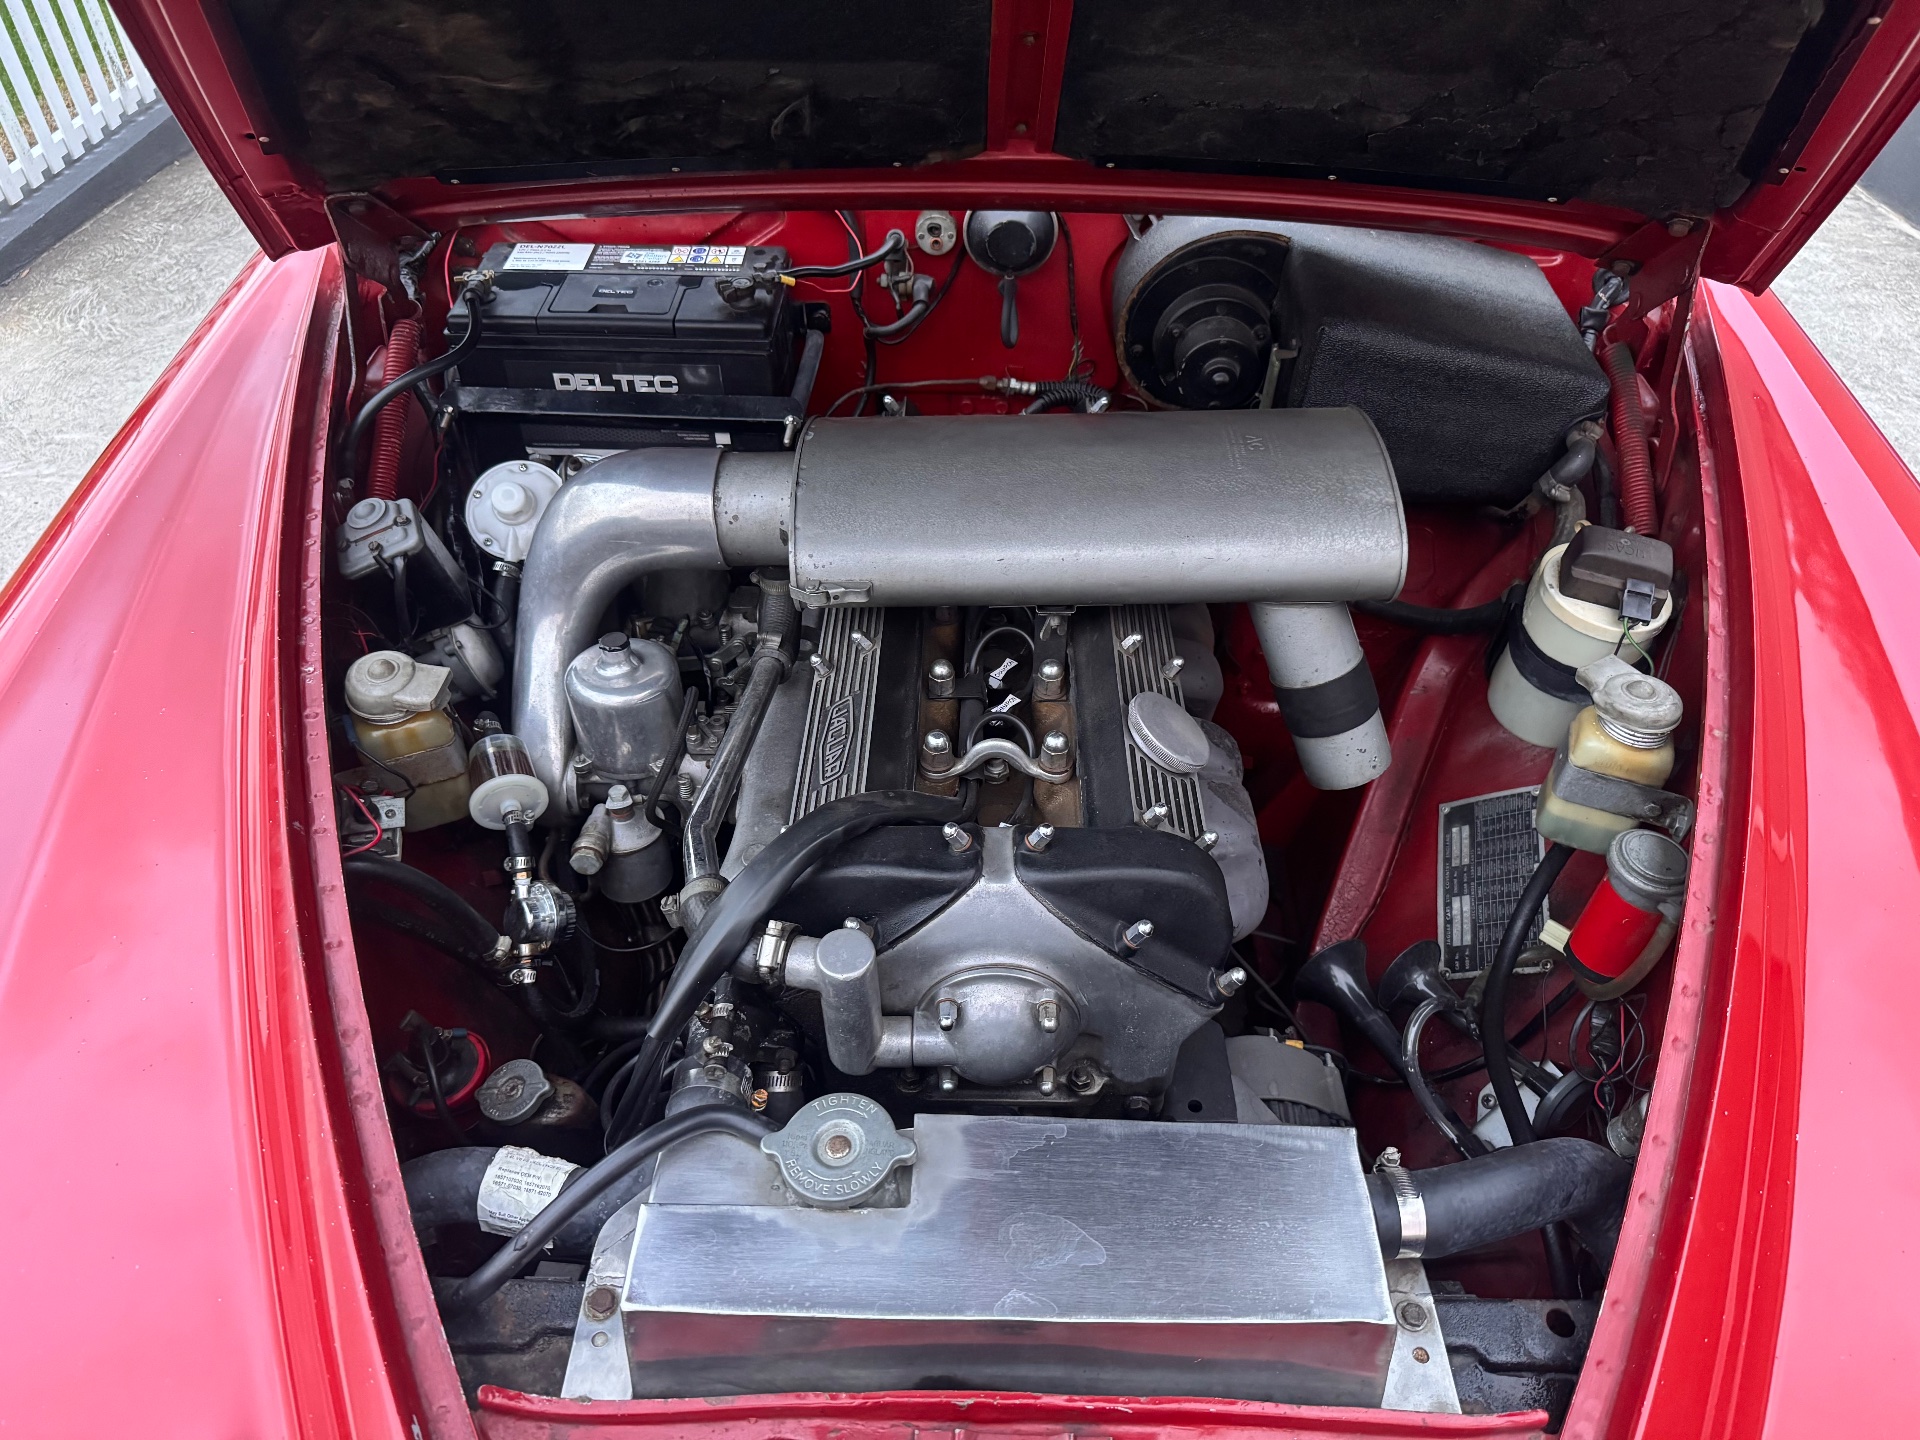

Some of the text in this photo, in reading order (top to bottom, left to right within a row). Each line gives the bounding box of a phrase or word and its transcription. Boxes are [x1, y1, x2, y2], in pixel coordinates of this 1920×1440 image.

[552, 372, 679, 394] DELTEC
[823, 704, 848, 777] JAGUAR
[811, 1095, 879, 1114] TIGHTEN
[786, 1158, 882, 1195] REMOVE SLOWLY
